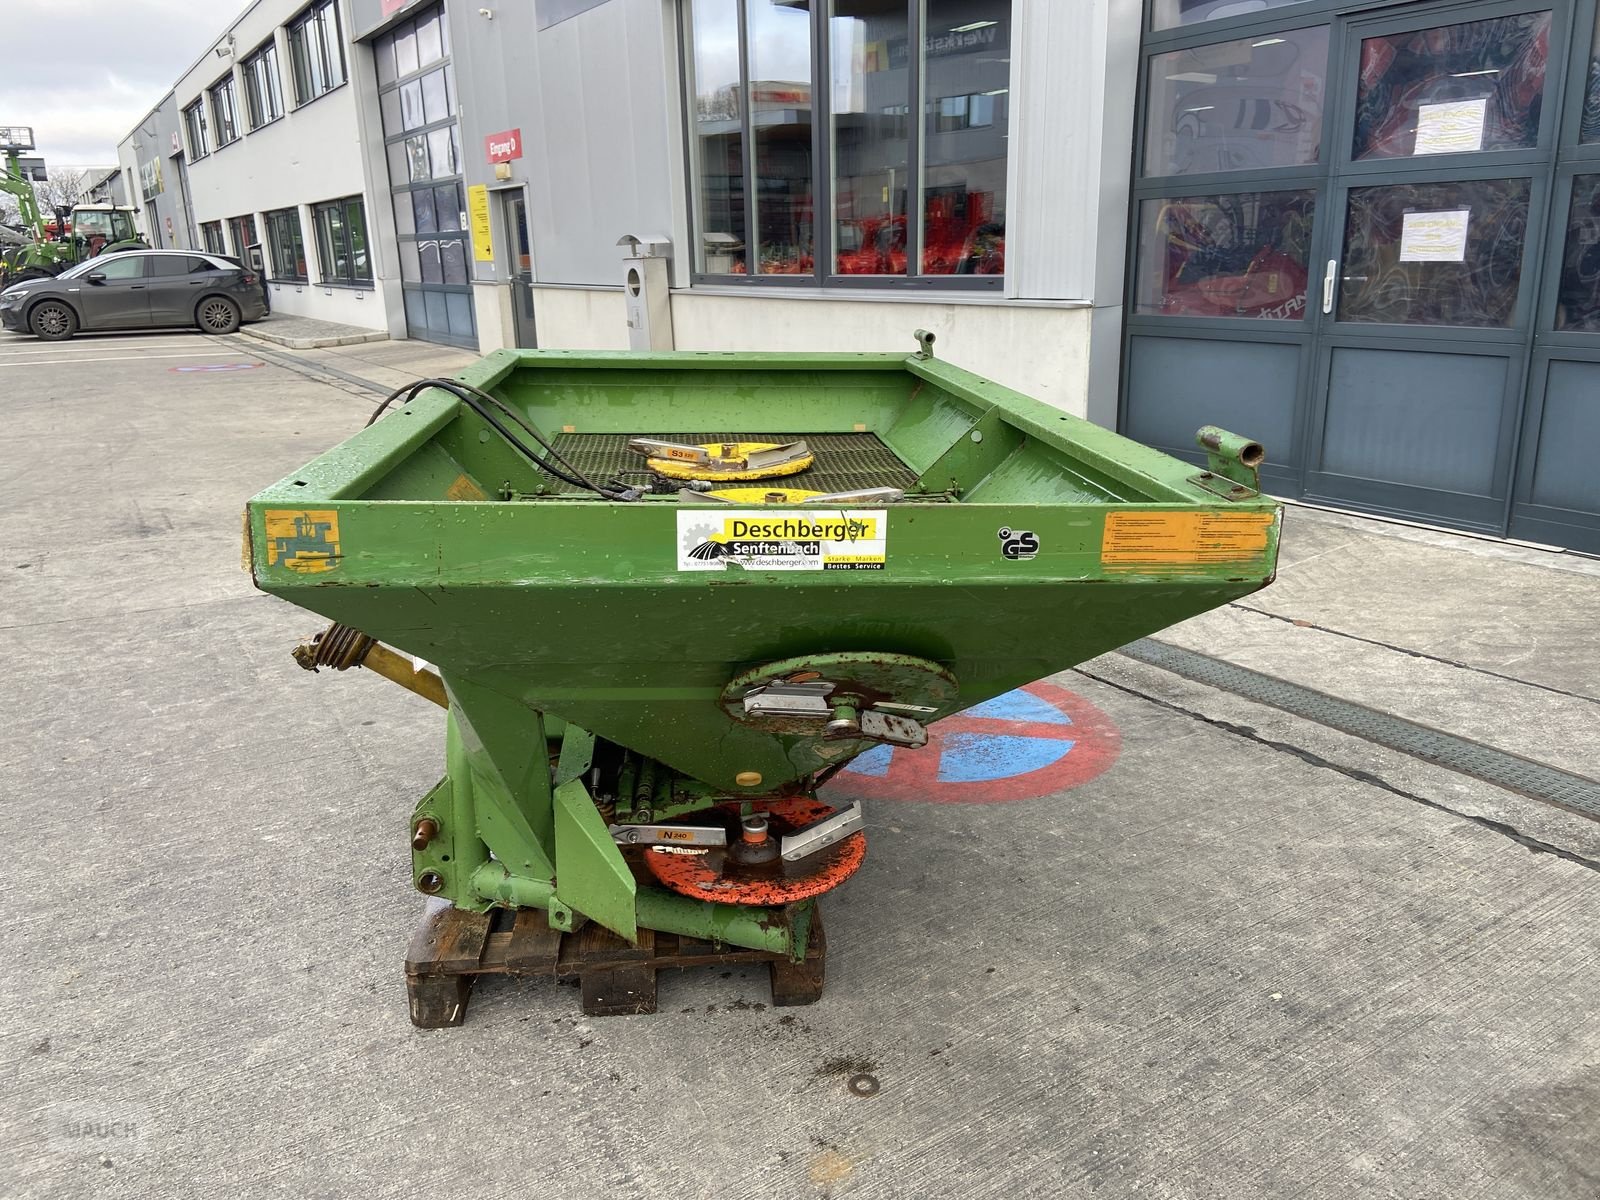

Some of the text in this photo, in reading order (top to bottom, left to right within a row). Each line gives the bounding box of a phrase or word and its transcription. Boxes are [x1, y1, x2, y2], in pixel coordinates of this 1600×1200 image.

[490, 137, 516, 156] Eingang D
[733, 518, 869, 541] Deschberger
[733, 541, 819, 555] Senftenbach
[1003, 532, 1038, 554] GS
[663, 831, 673, 839] N
